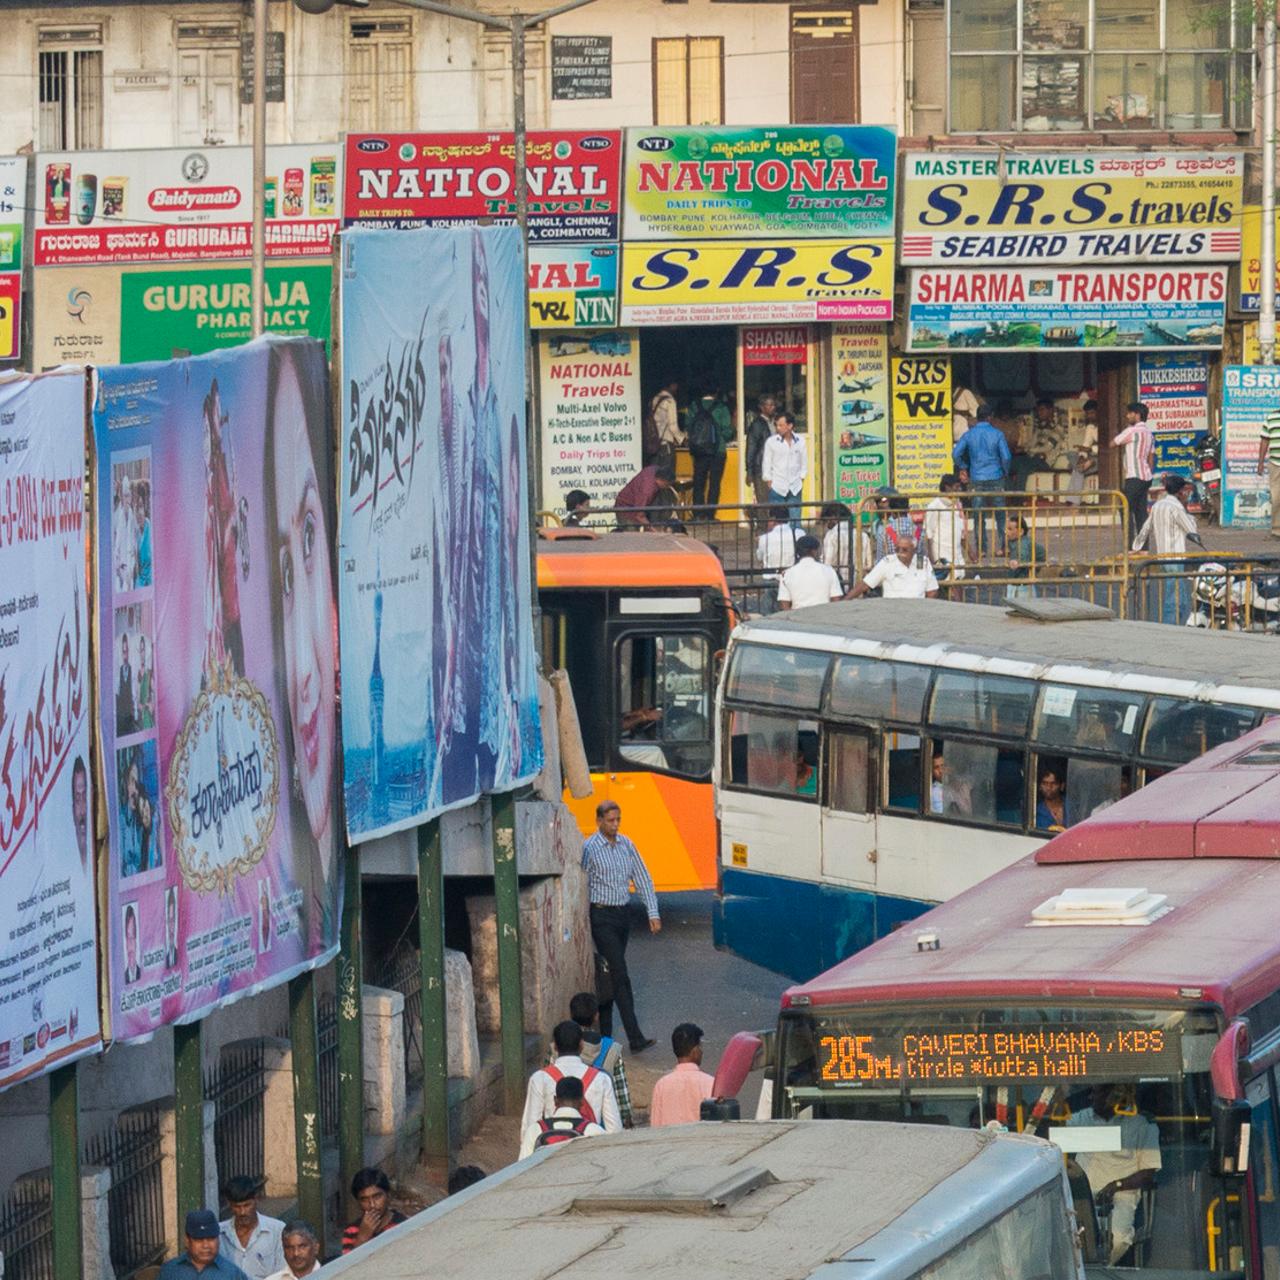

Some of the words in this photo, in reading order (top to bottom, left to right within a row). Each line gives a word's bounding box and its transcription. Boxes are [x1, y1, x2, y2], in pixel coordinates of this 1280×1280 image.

[362, 141, 385, 150] NTN
[643, 139, 669, 150] NTJ
[915, 160, 998, 176] MASTER
[1005, 158, 1095, 175] TRAVELS
[1100, 157, 1166, 177] ಮಾಸ್ಟರ್
[1176, 156, 1236, 175] ಟ್ರಾವೆಲ್ಸ್
[357, 166, 607, 199] NATIONAL
[638, 159, 887, 192] NATIONAL
[151, 189, 237, 208] Baidyanath
[667, 200, 697, 209] DAILY
[702, 200, 730, 208] TRIPS
[788, 194, 885, 209] Travels
[919, 182, 1124, 226] S.R.S.
[1129, 196, 1233, 224] travels
[565, 217, 611, 226] CHENNAI,
[767, 222, 785, 231] GOA
[165, 227, 247, 247] GURURAJA
[541, 227, 611, 238] COIMBATORE,
[40, 233, 100, 250] ಗುರುರಾಜ
[941, 236, 1068, 258] SEABIRD
[1076, 233, 1205, 255] TRAVELS
[632, 244, 883, 290] S.R.S
[806, 288, 882, 297] travels
[918, 274, 1025, 302] SHARMA
[1058, 272, 1224, 301] TRANSPORTS
[532, 301, 570, 321] VRL
[575, 298, 615, 322] NTN
[54, 336, 104, 347] ಗುರುರಾಜ
[745, 329, 805, 349] SHARMA
[840, 337, 878, 347] Travels
[550, 363, 632, 379] NATIONAL
[897, 359, 948, 385] SRS
[1142, 368, 1206, 384] KUKKESHREE
[562, 383, 625, 397] Travels
[557, 404, 601, 414] Multi-Axel
[604, 403, 627, 412] Volvo
[896, 391, 950, 417] VRL
[600, 418, 623, 427] Sleeper
[1156, 420, 1194, 429] SHIMOGA
[568, 434, 573, 443] &
[576, 434, 591, 443] Non
[609, 433, 632, 442] Buses
[560, 451, 584, 460] Daily
[587, 451, 610, 459] Trips
[841, 456, 852, 464] For
[853, 455, 880, 464] Bookings
[551, 465, 582, 475] BOMBAY,
[856, 471, 880, 480] Ticket
[840, 487, 855, 497] Bus
[904, 1033, 989, 1057] CAVERI
[995, 1033, 1101, 1054] BHAVANA
[907, 1057, 965, 1078] Circle
[1044, 1054, 1087, 1076] halli
